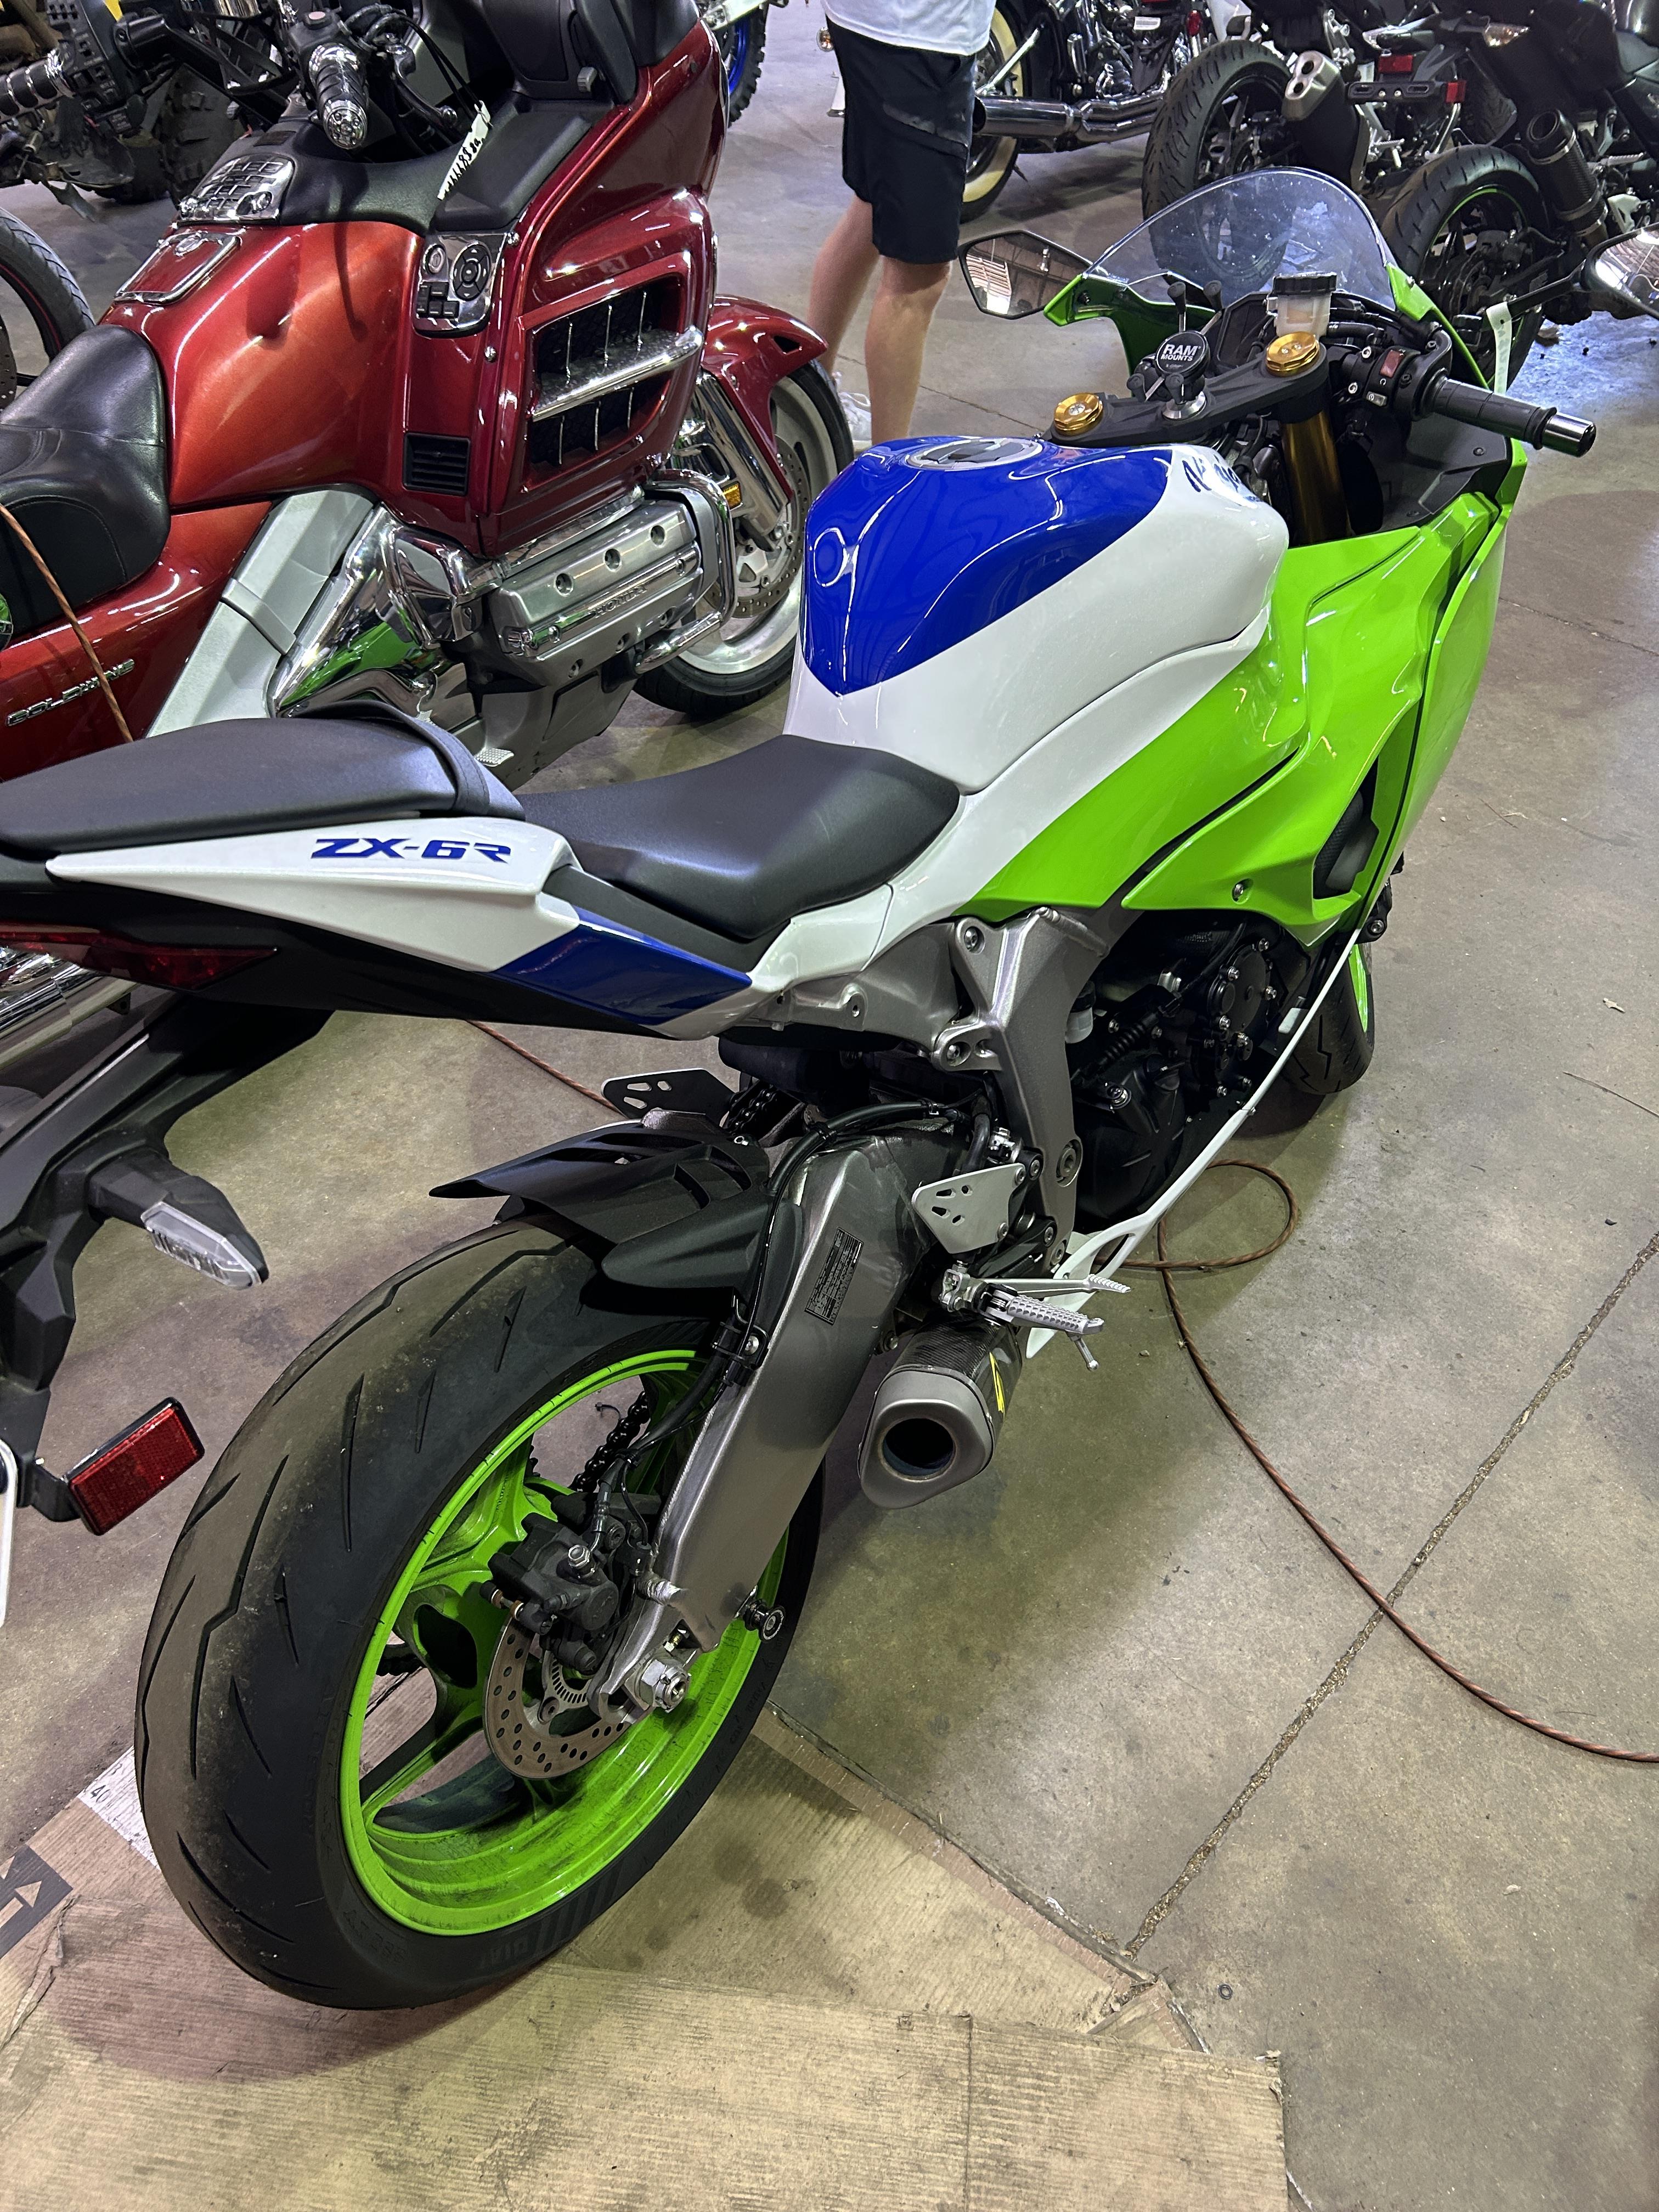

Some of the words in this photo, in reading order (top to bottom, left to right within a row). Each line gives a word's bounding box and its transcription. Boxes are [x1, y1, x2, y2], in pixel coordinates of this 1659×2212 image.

[1163, 343, 1198, 356] RAM
[595, 584, 648, 619] HONDA
[311, 838, 511, 864] ZX-6R
